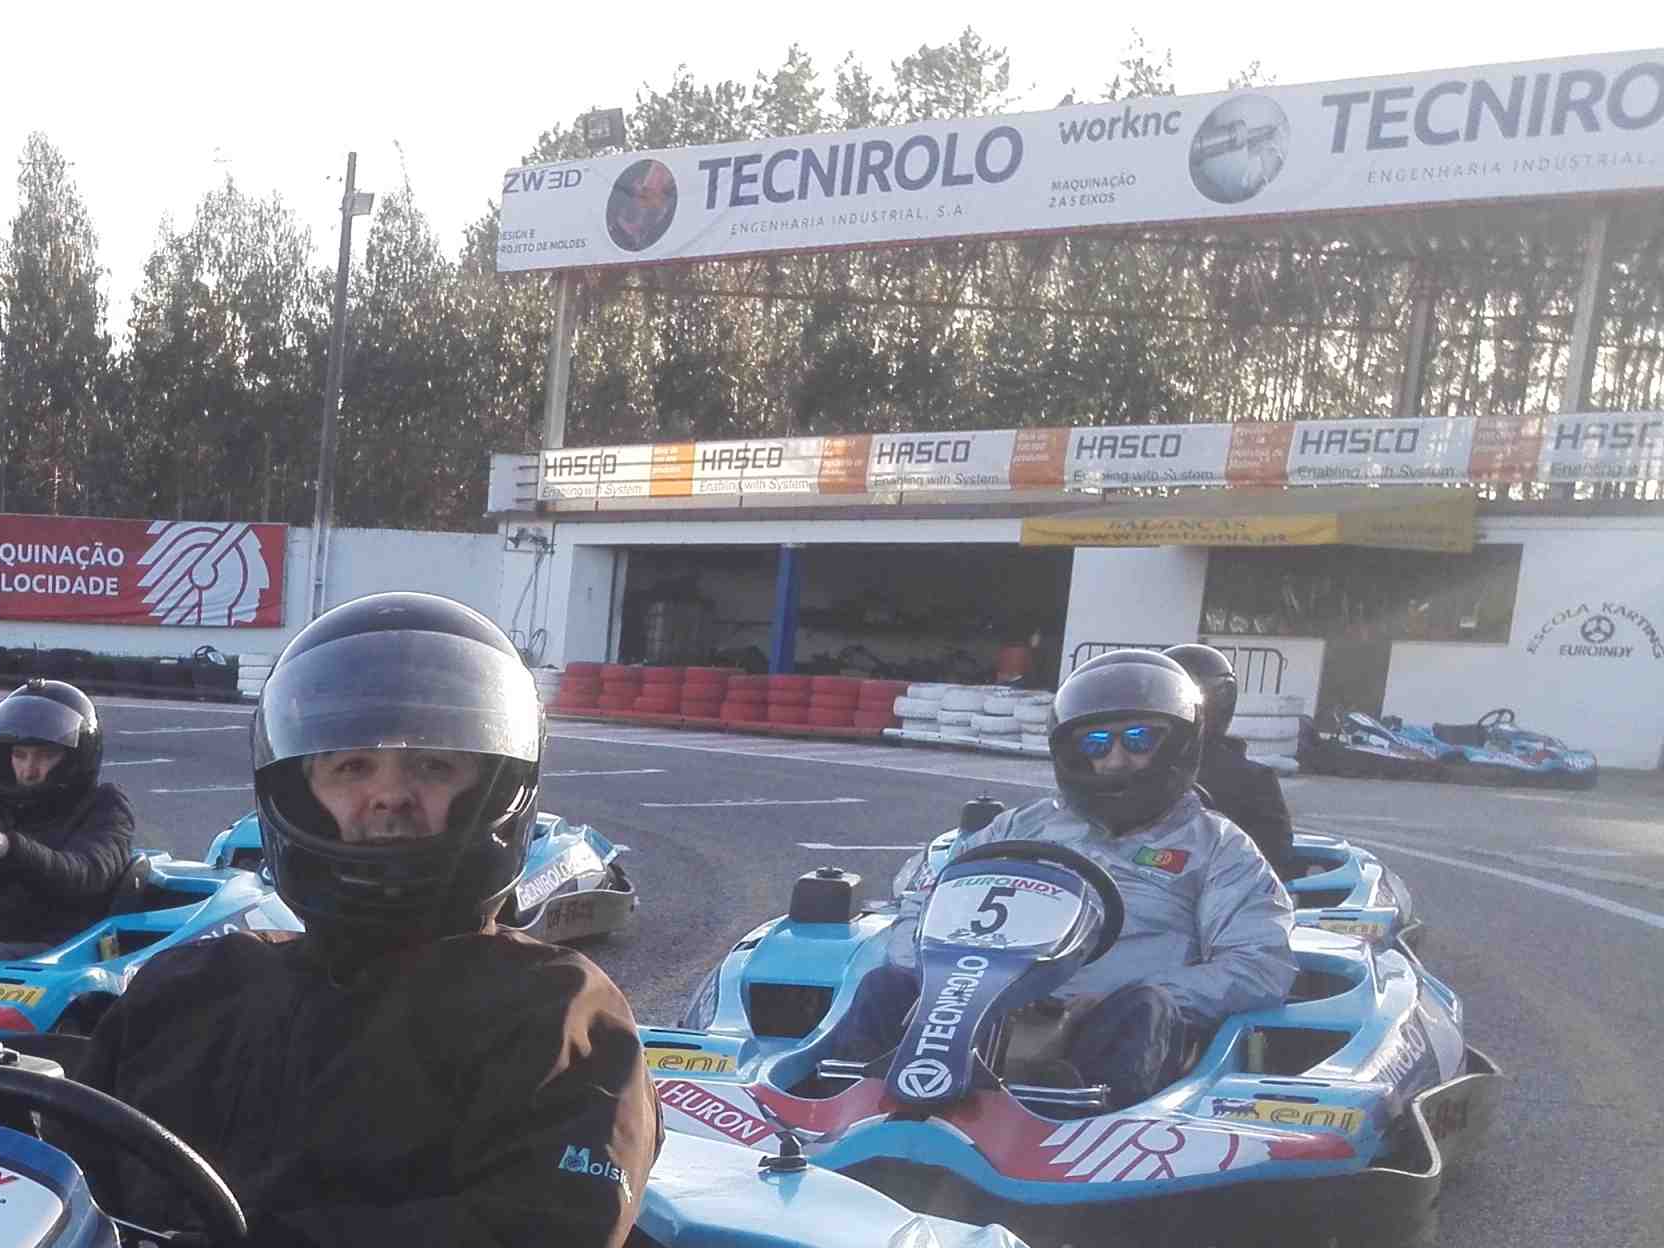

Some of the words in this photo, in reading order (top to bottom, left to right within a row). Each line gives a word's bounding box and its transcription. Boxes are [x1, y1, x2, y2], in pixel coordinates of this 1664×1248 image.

[1058, 106, 1181, 144] worknc
[699, 126, 1023, 209] TECNIROLO
[1367, 161, 1502, 183] ENGENHARIA
[1051, 169, 1136, 192] MAQUINAÇÃO
[1080, 192, 1115, 206] EIXOS
[730, 217, 824, 236] ENGENHARIA
[937, 204, 968, 218] S.A.
[500, 230, 528, 241] ESIGN
[500, 244, 536, 254] ROJETO
[877, 440, 970, 464] HASCO
[1076, 434, 1181, 459] HASCO
[1300, 428, 1419, 454] HASCO
[544, 455, 616, 477] HASCO
[702, 447, 783, 471] HASCO
[1559, 644, 1634, 658] EUROINDY
[952, 877, 1064, 896] EUROINDY
[970, 886, 1017, 936] 5
[915, 955, 989, 1056] TECNIROLO
[658, 1054, 729, 1073] eni
[661, 1083, 766, 1139] HURON
[1269, 1106, 1355, 1131] eni
